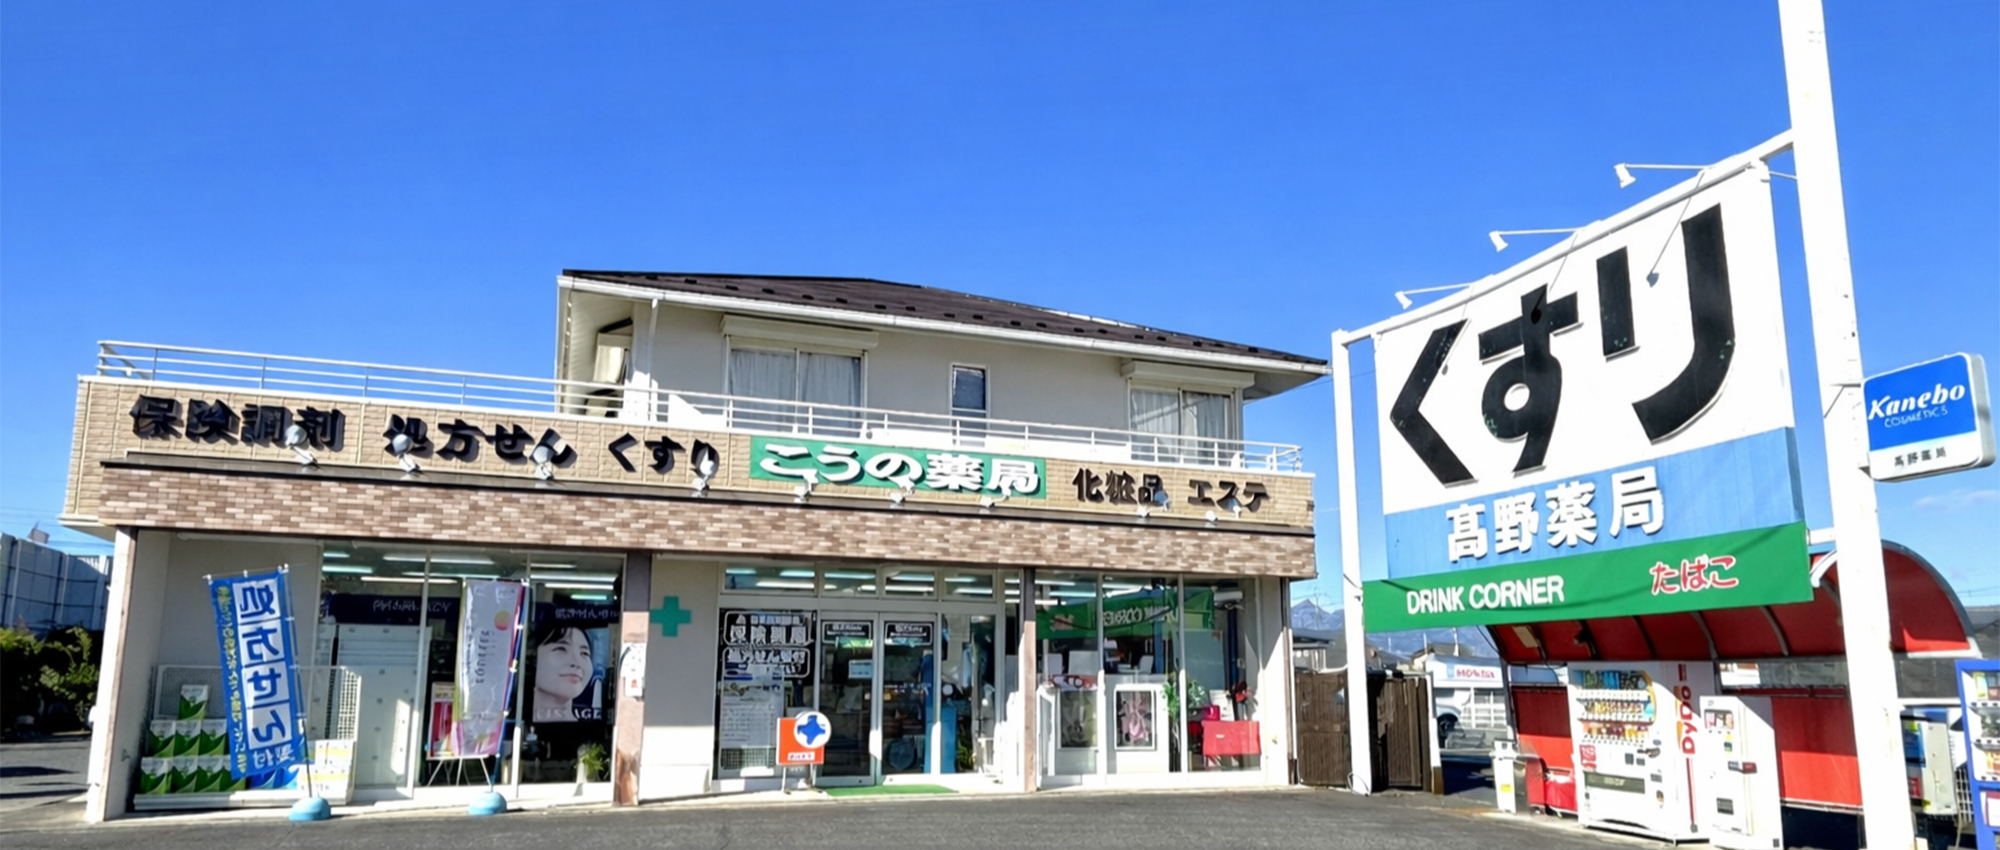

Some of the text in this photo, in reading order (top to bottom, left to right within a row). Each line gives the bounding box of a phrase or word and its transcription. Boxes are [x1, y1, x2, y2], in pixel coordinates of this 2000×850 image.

[1390, 203, 1736, 487] くすり
[1868, 383, 1965, 420] Kanebo
[129, 394, 720, 477] 保険調剤 処方せん くすり
[759, 443, 1042, 495] こうの薬局
[1072, 467, 1271, 512] 化粧品 エステ
[1405, 575, 1565, 615] DRINK CORNER
[1648, 554, 1740, 595] たばこ
[1680, 686, 1697, 755] DyDo
